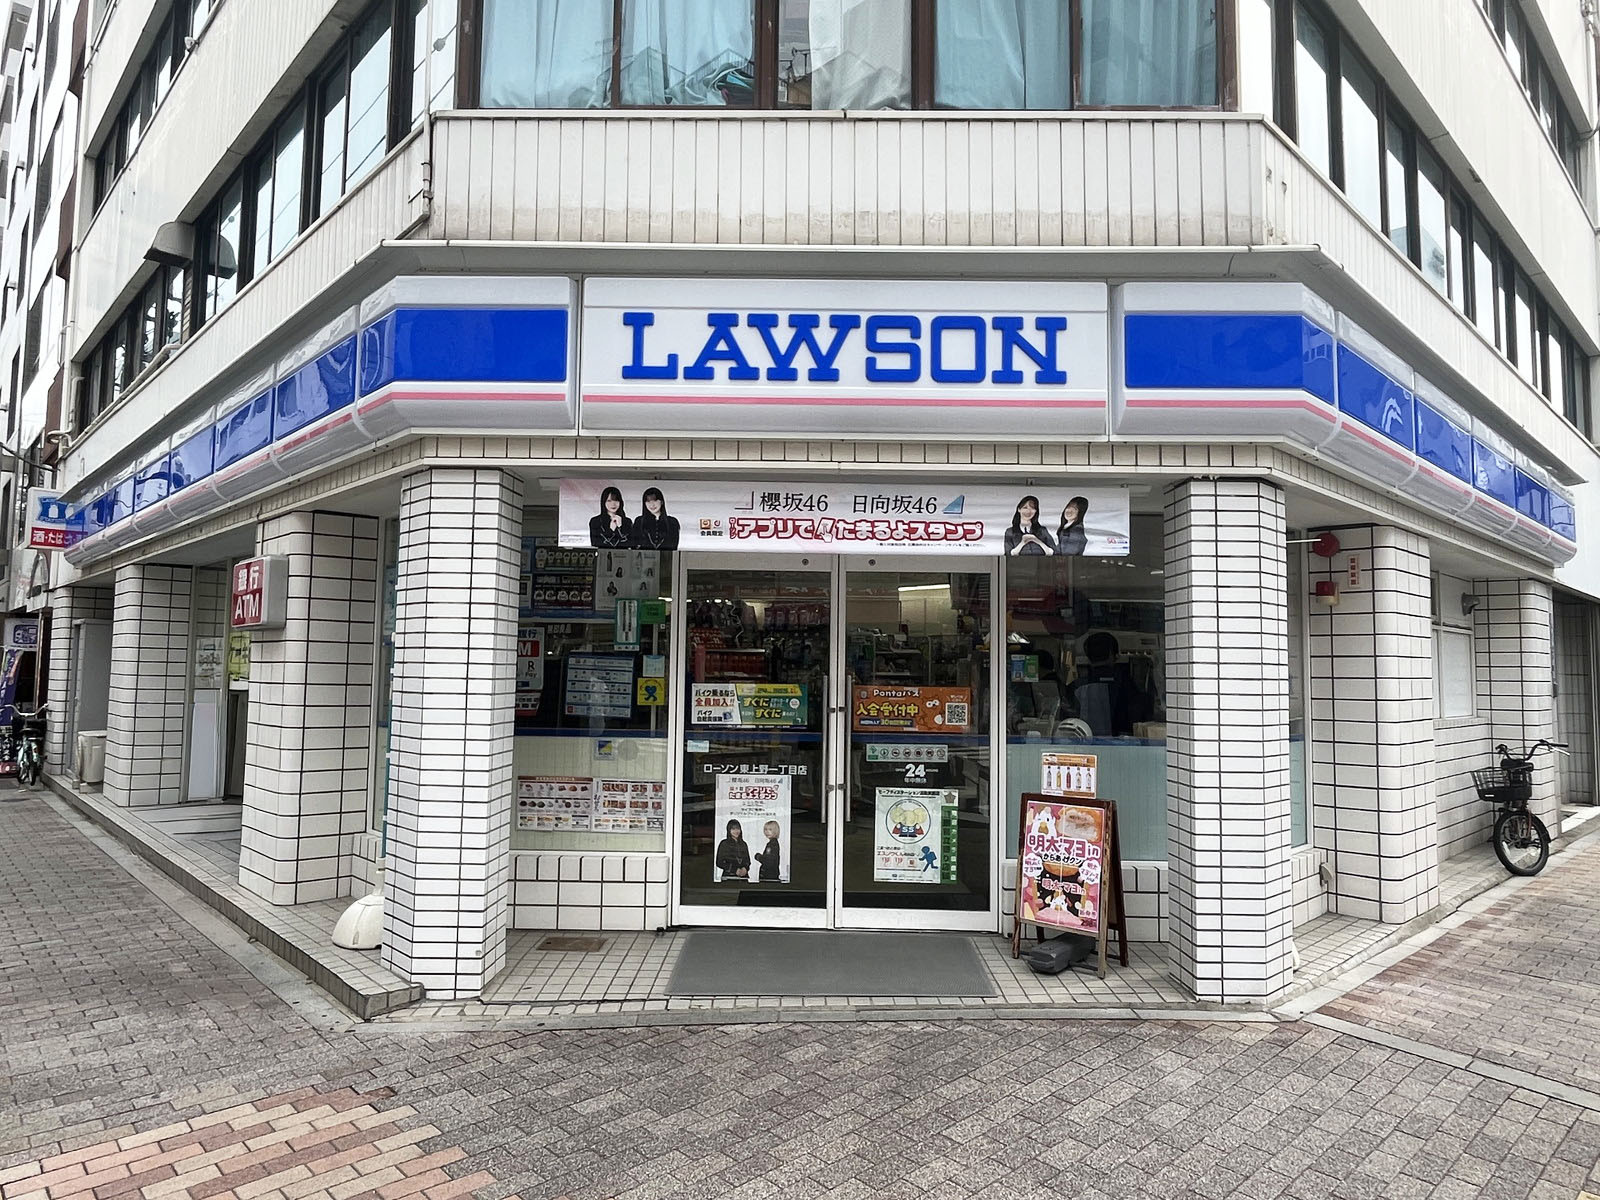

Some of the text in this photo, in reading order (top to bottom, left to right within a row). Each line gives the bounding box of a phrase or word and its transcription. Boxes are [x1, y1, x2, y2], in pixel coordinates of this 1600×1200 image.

[621, 312, 1067, 385] LAWSON
[759, 491, 938, 515] 櫻坂46 日向坂46
[835, 519, 985, 541] たまるよスタンプ
[238, 565, 260, 592] 銀行
[234, 592, 259, 620] ATM
[695, 688, 736, 697] バイク乗るなら
[873, 688, 921, 698] Pontaパス
[743, 697, 770, 707] すぐに
[755, 708, 782, 719] すぐに
[856, 702, 920, 718] 入会受付中
[703, 763, 808, 775] ローソン 東上野一丁目店
[905, 763, 926, 778] 24
[1043, 853, 1083, 866] からあげクン
